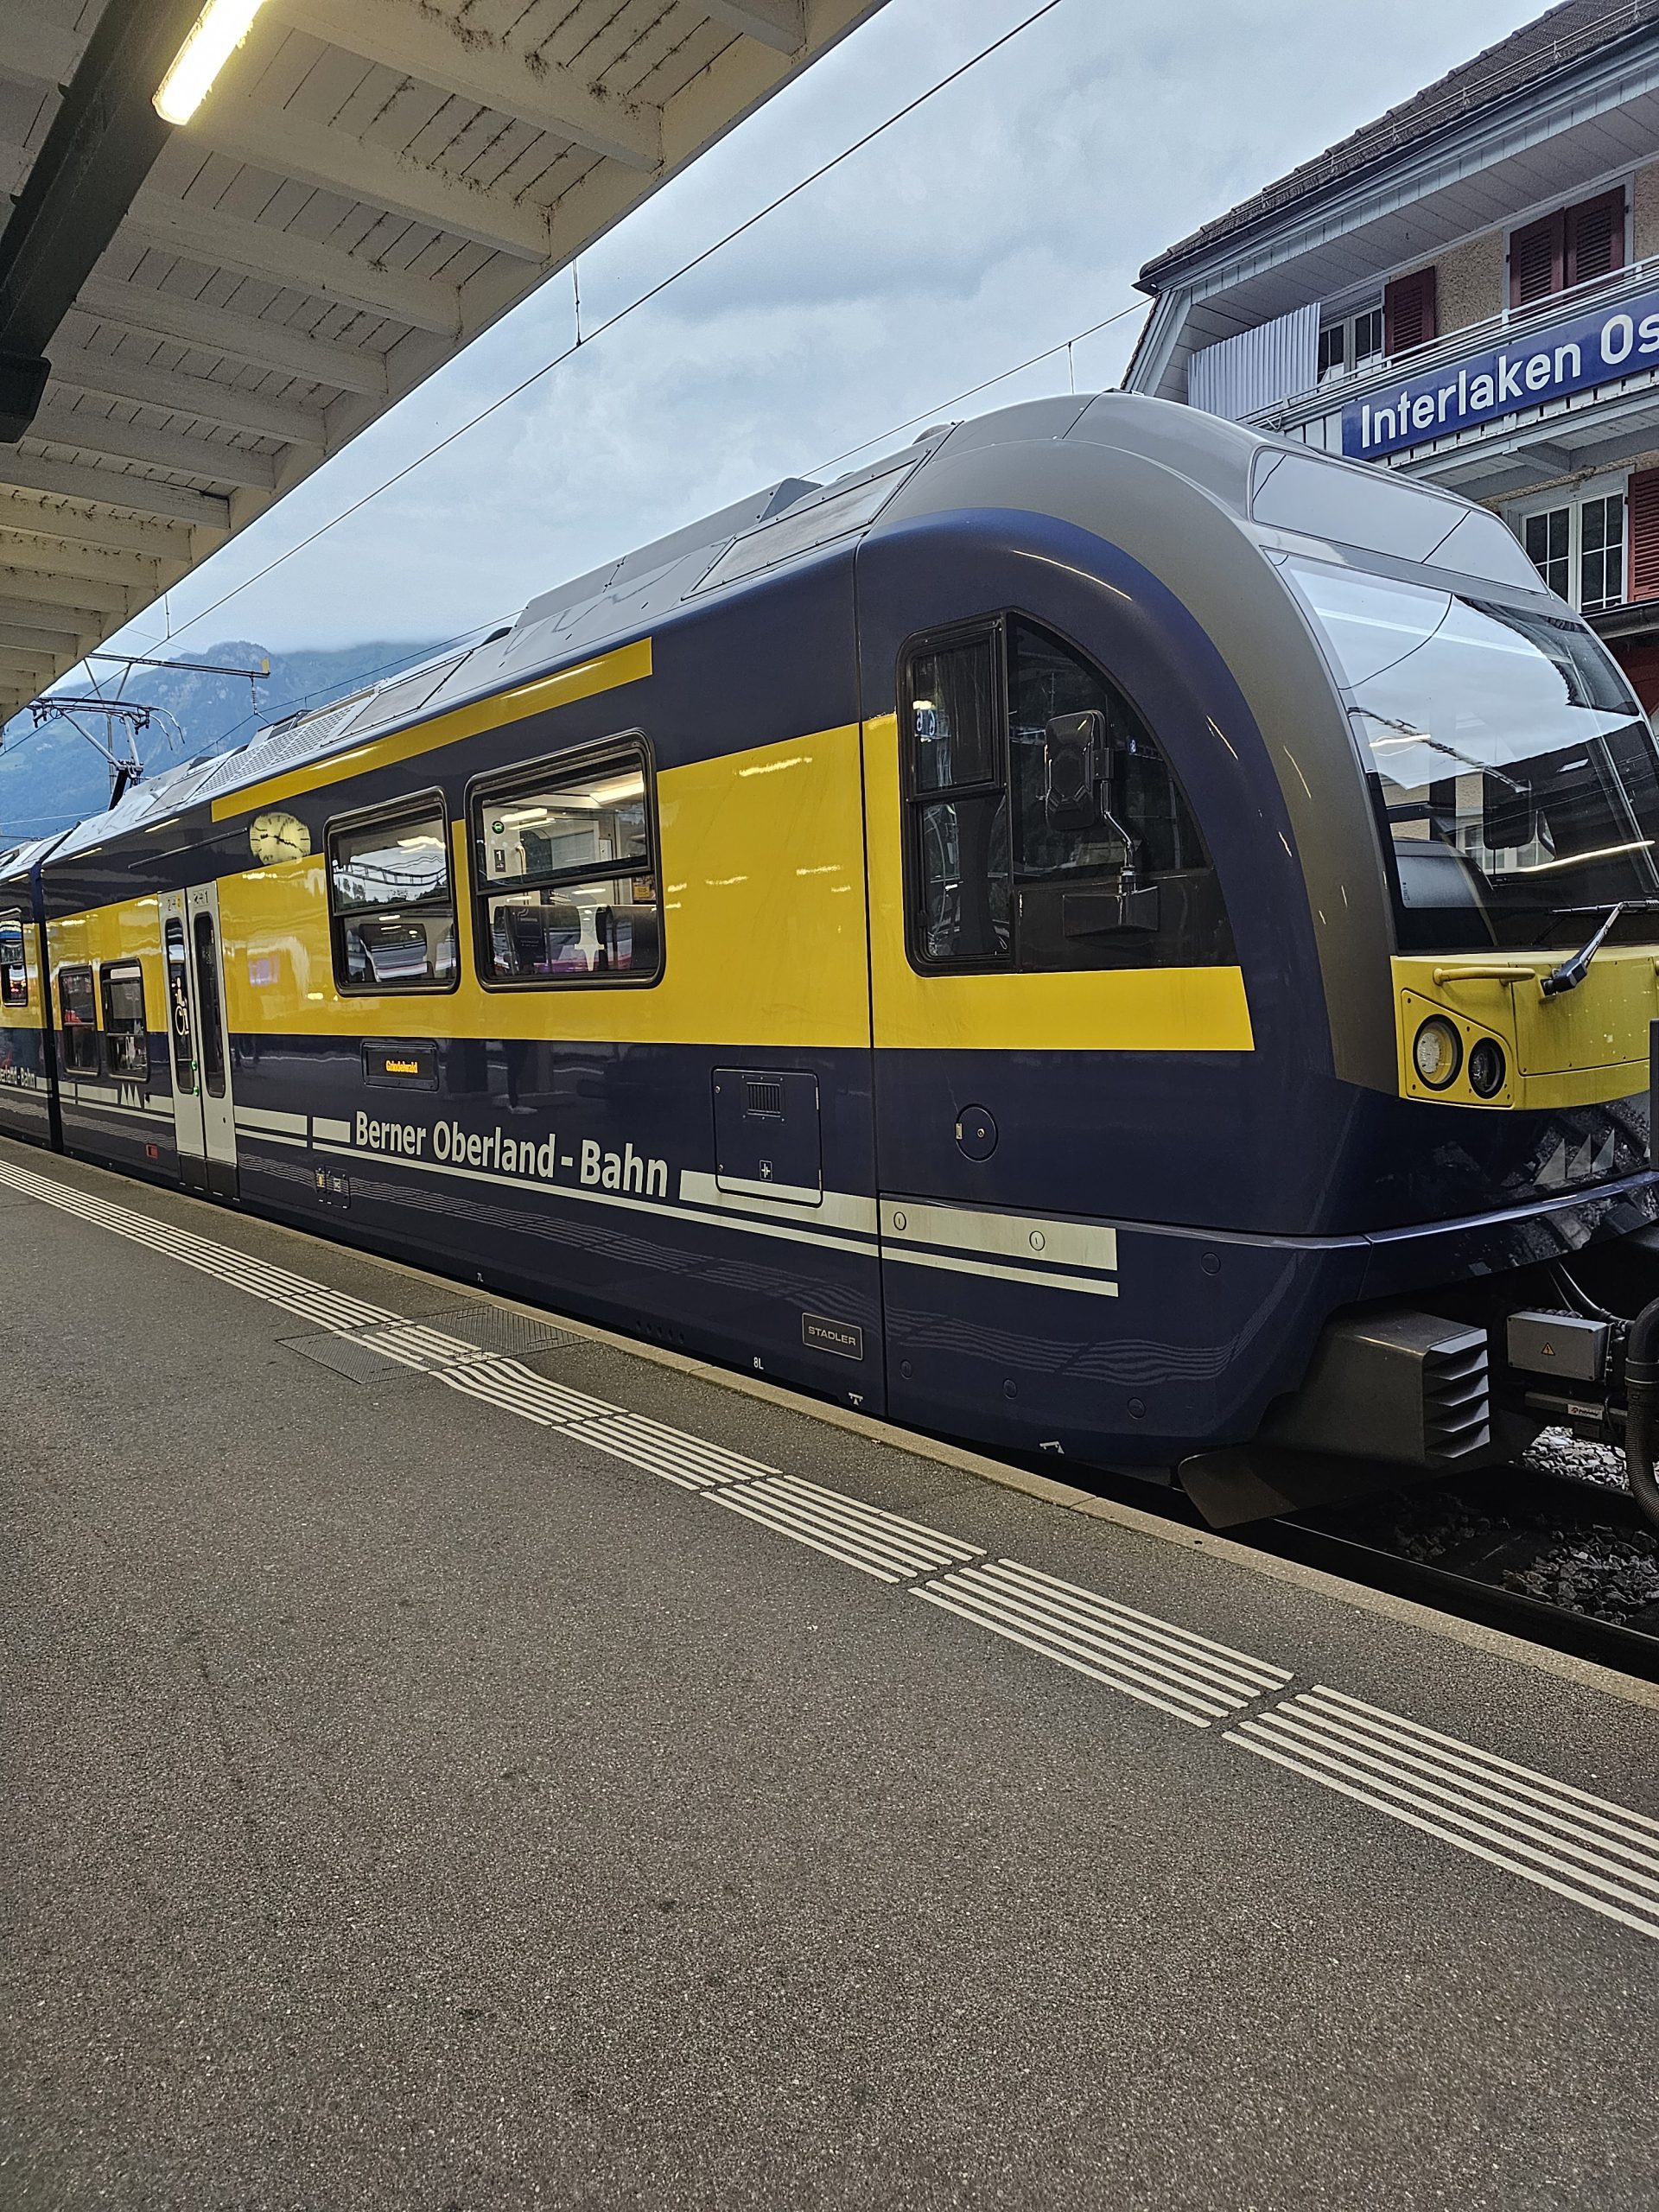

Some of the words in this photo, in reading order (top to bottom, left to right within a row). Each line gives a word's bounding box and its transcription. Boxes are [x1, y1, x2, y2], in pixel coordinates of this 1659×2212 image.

[1362, 343, 1581, 448] Interlaken
[356, 1110, 427, 1155] Berner
[808, 1325, 856, 1346] STADLER
[753, 1357, 764, 1370] 8L
